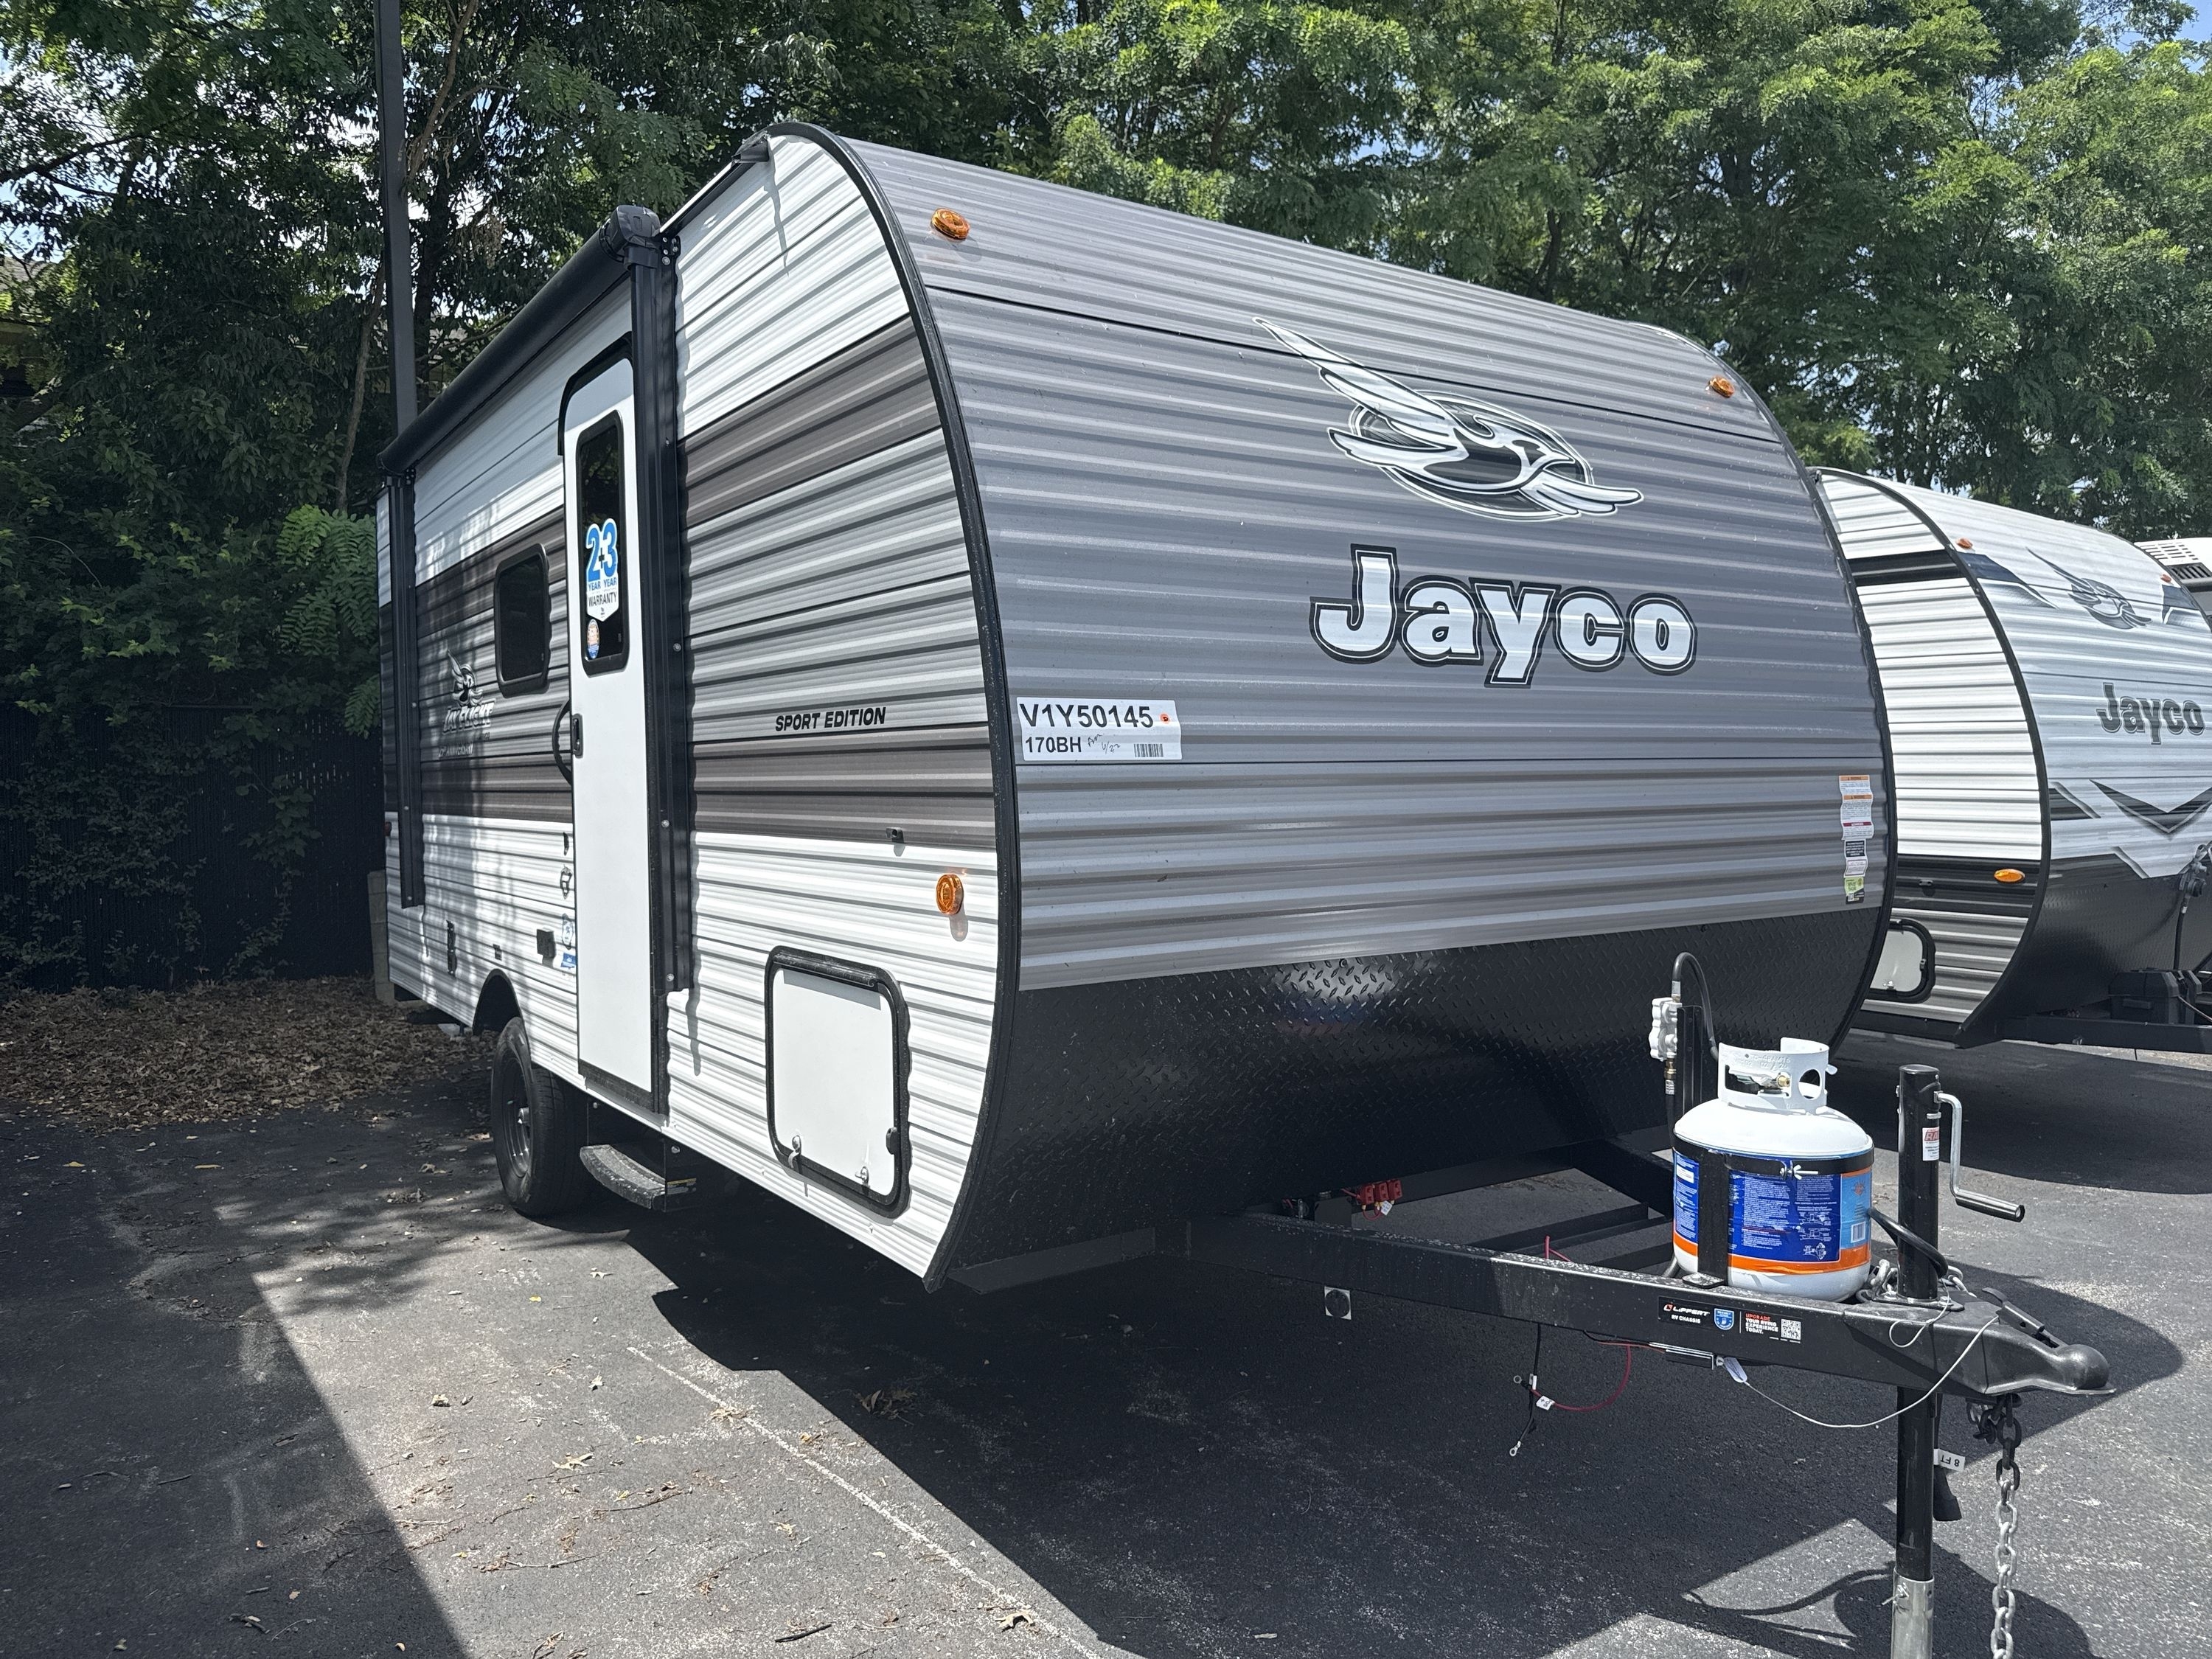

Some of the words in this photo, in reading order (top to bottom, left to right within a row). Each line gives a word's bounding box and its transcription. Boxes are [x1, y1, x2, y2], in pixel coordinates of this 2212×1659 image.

[588, 581, 601, 591] YEAR
[603, 577, 617, 588] YEAR
[588, 591, 617, 607] WARRANTY
[1310, 543, 1697, 688] Jayco
[775, 712, 821, 731] SPORT
[824, 706, 886, 728] EDITION
[1019, 703, 1153, 728] V1Y50145
[2096, 682, 2206, 745] Jayco
[1026, 737, 1082, 753] 170BH
[1924, 1131, 1939, 1141] RA
[1679, 1315, 1701, 1324] CHASSIS
[1745, 1313, 1770, 1321] UPGRADE
[1745, 1322, 1778, 1332] EXPERIENCE
[1941, 1455, 1952, 1464] FT
[1954, 1459, 1960, 1467] 8
